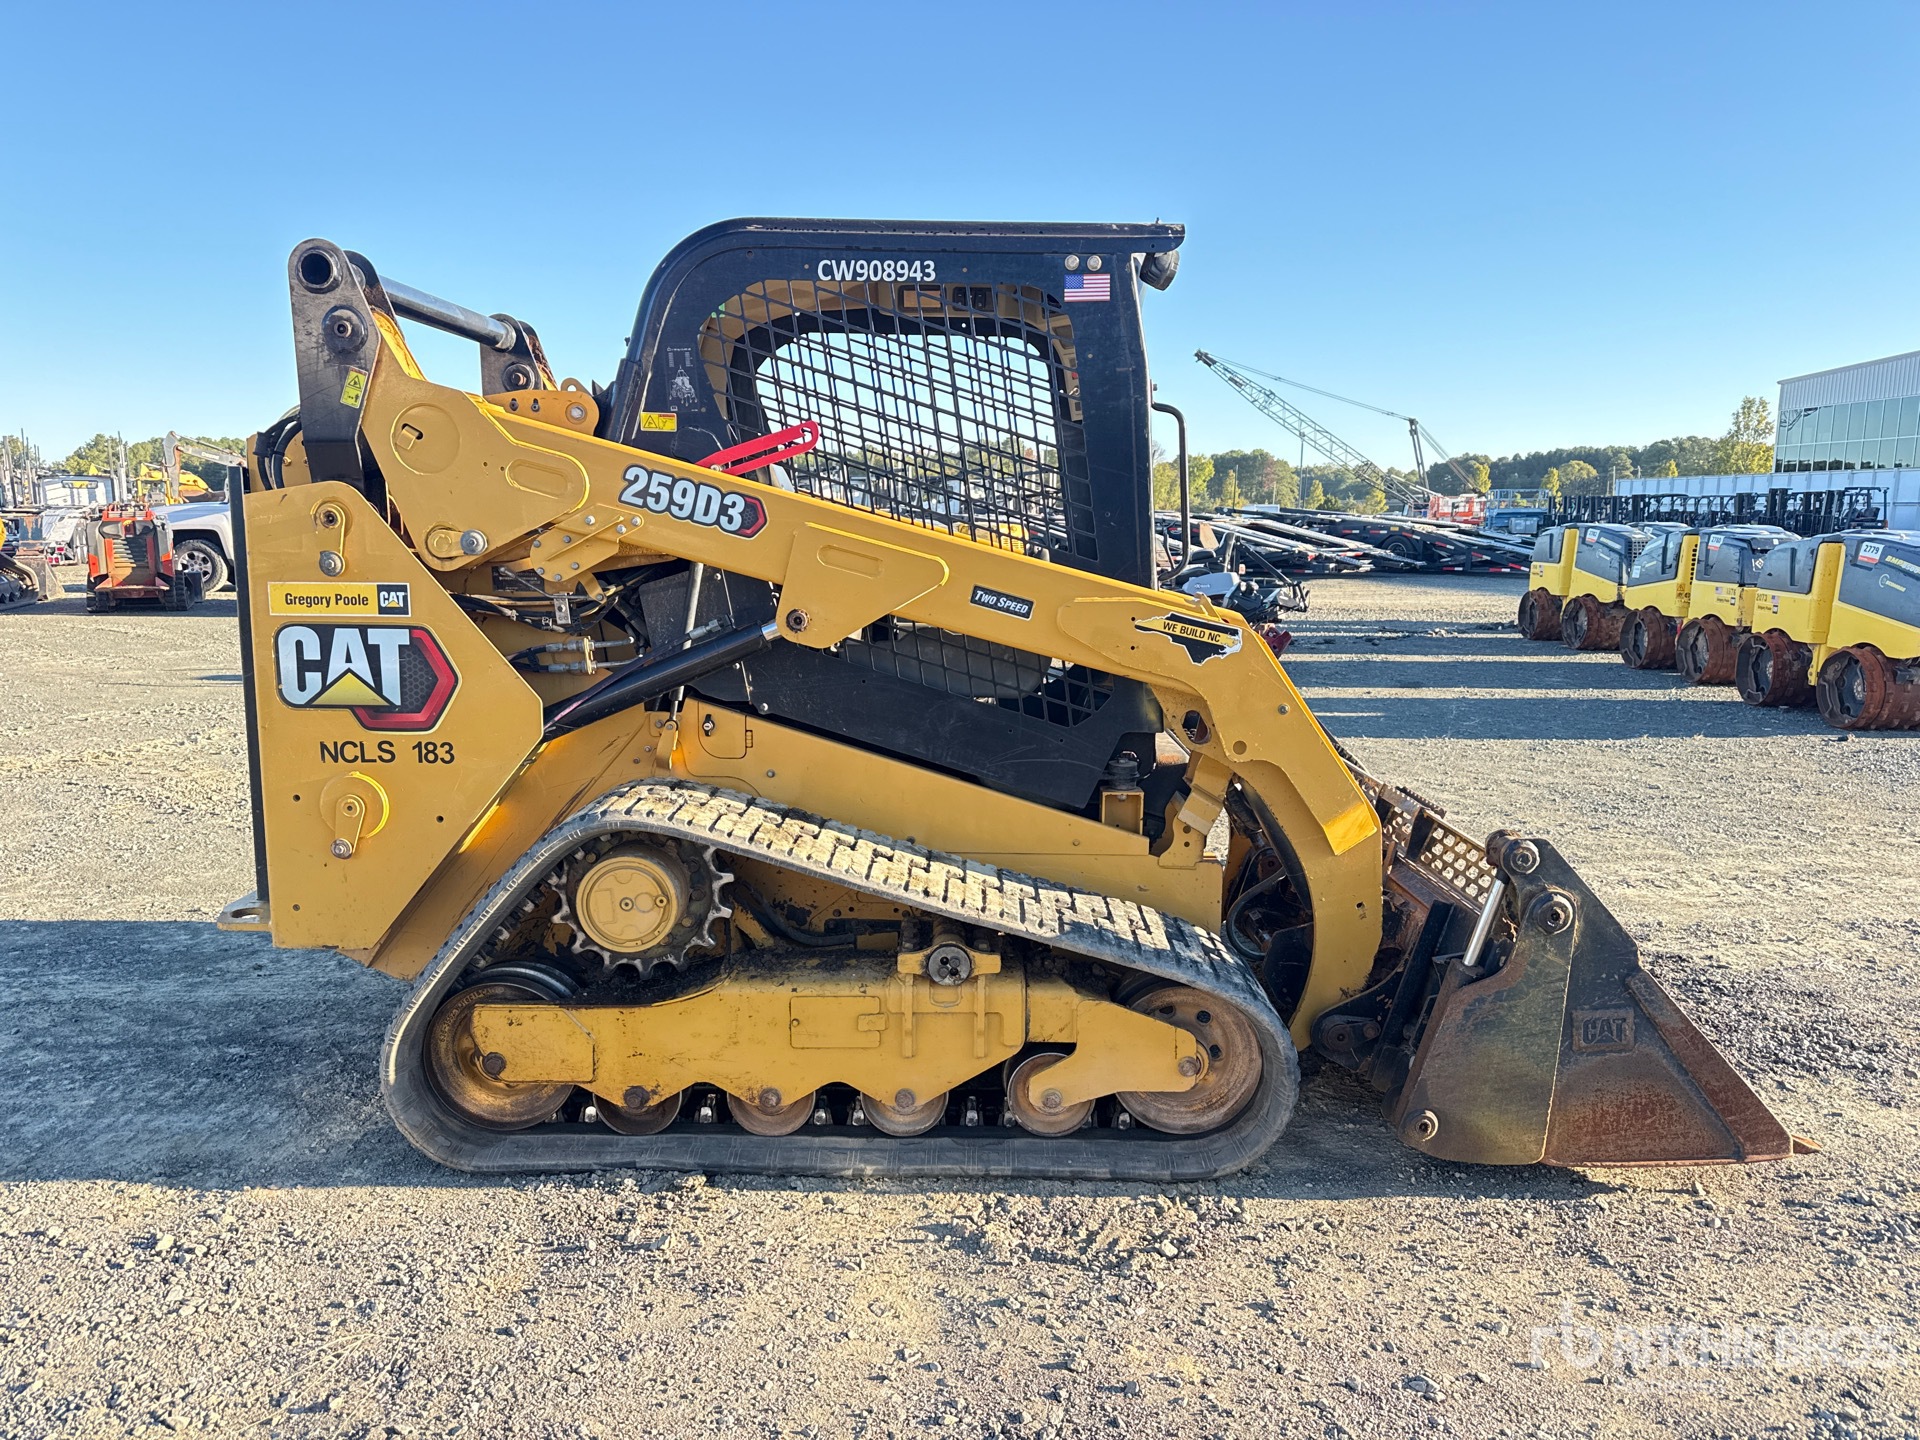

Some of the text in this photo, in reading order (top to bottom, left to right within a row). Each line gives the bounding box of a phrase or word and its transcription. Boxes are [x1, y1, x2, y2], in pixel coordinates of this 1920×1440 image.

[817, 259, 937, 282] CW908943
[620, 466, 745, 531] 259D3
[1863, 544, 1880, 555] 2779
[284, 592, 369, 608] Gregory Poole
[379, 591, 405, 608] CAT
[1163, 621, 1221, 643] WE BUILD NC
[278, 626, 410, 706] CAT
[320, 740, 455, 764] NCLS 183
[1582, 1017, 1627, 1045] CAT
